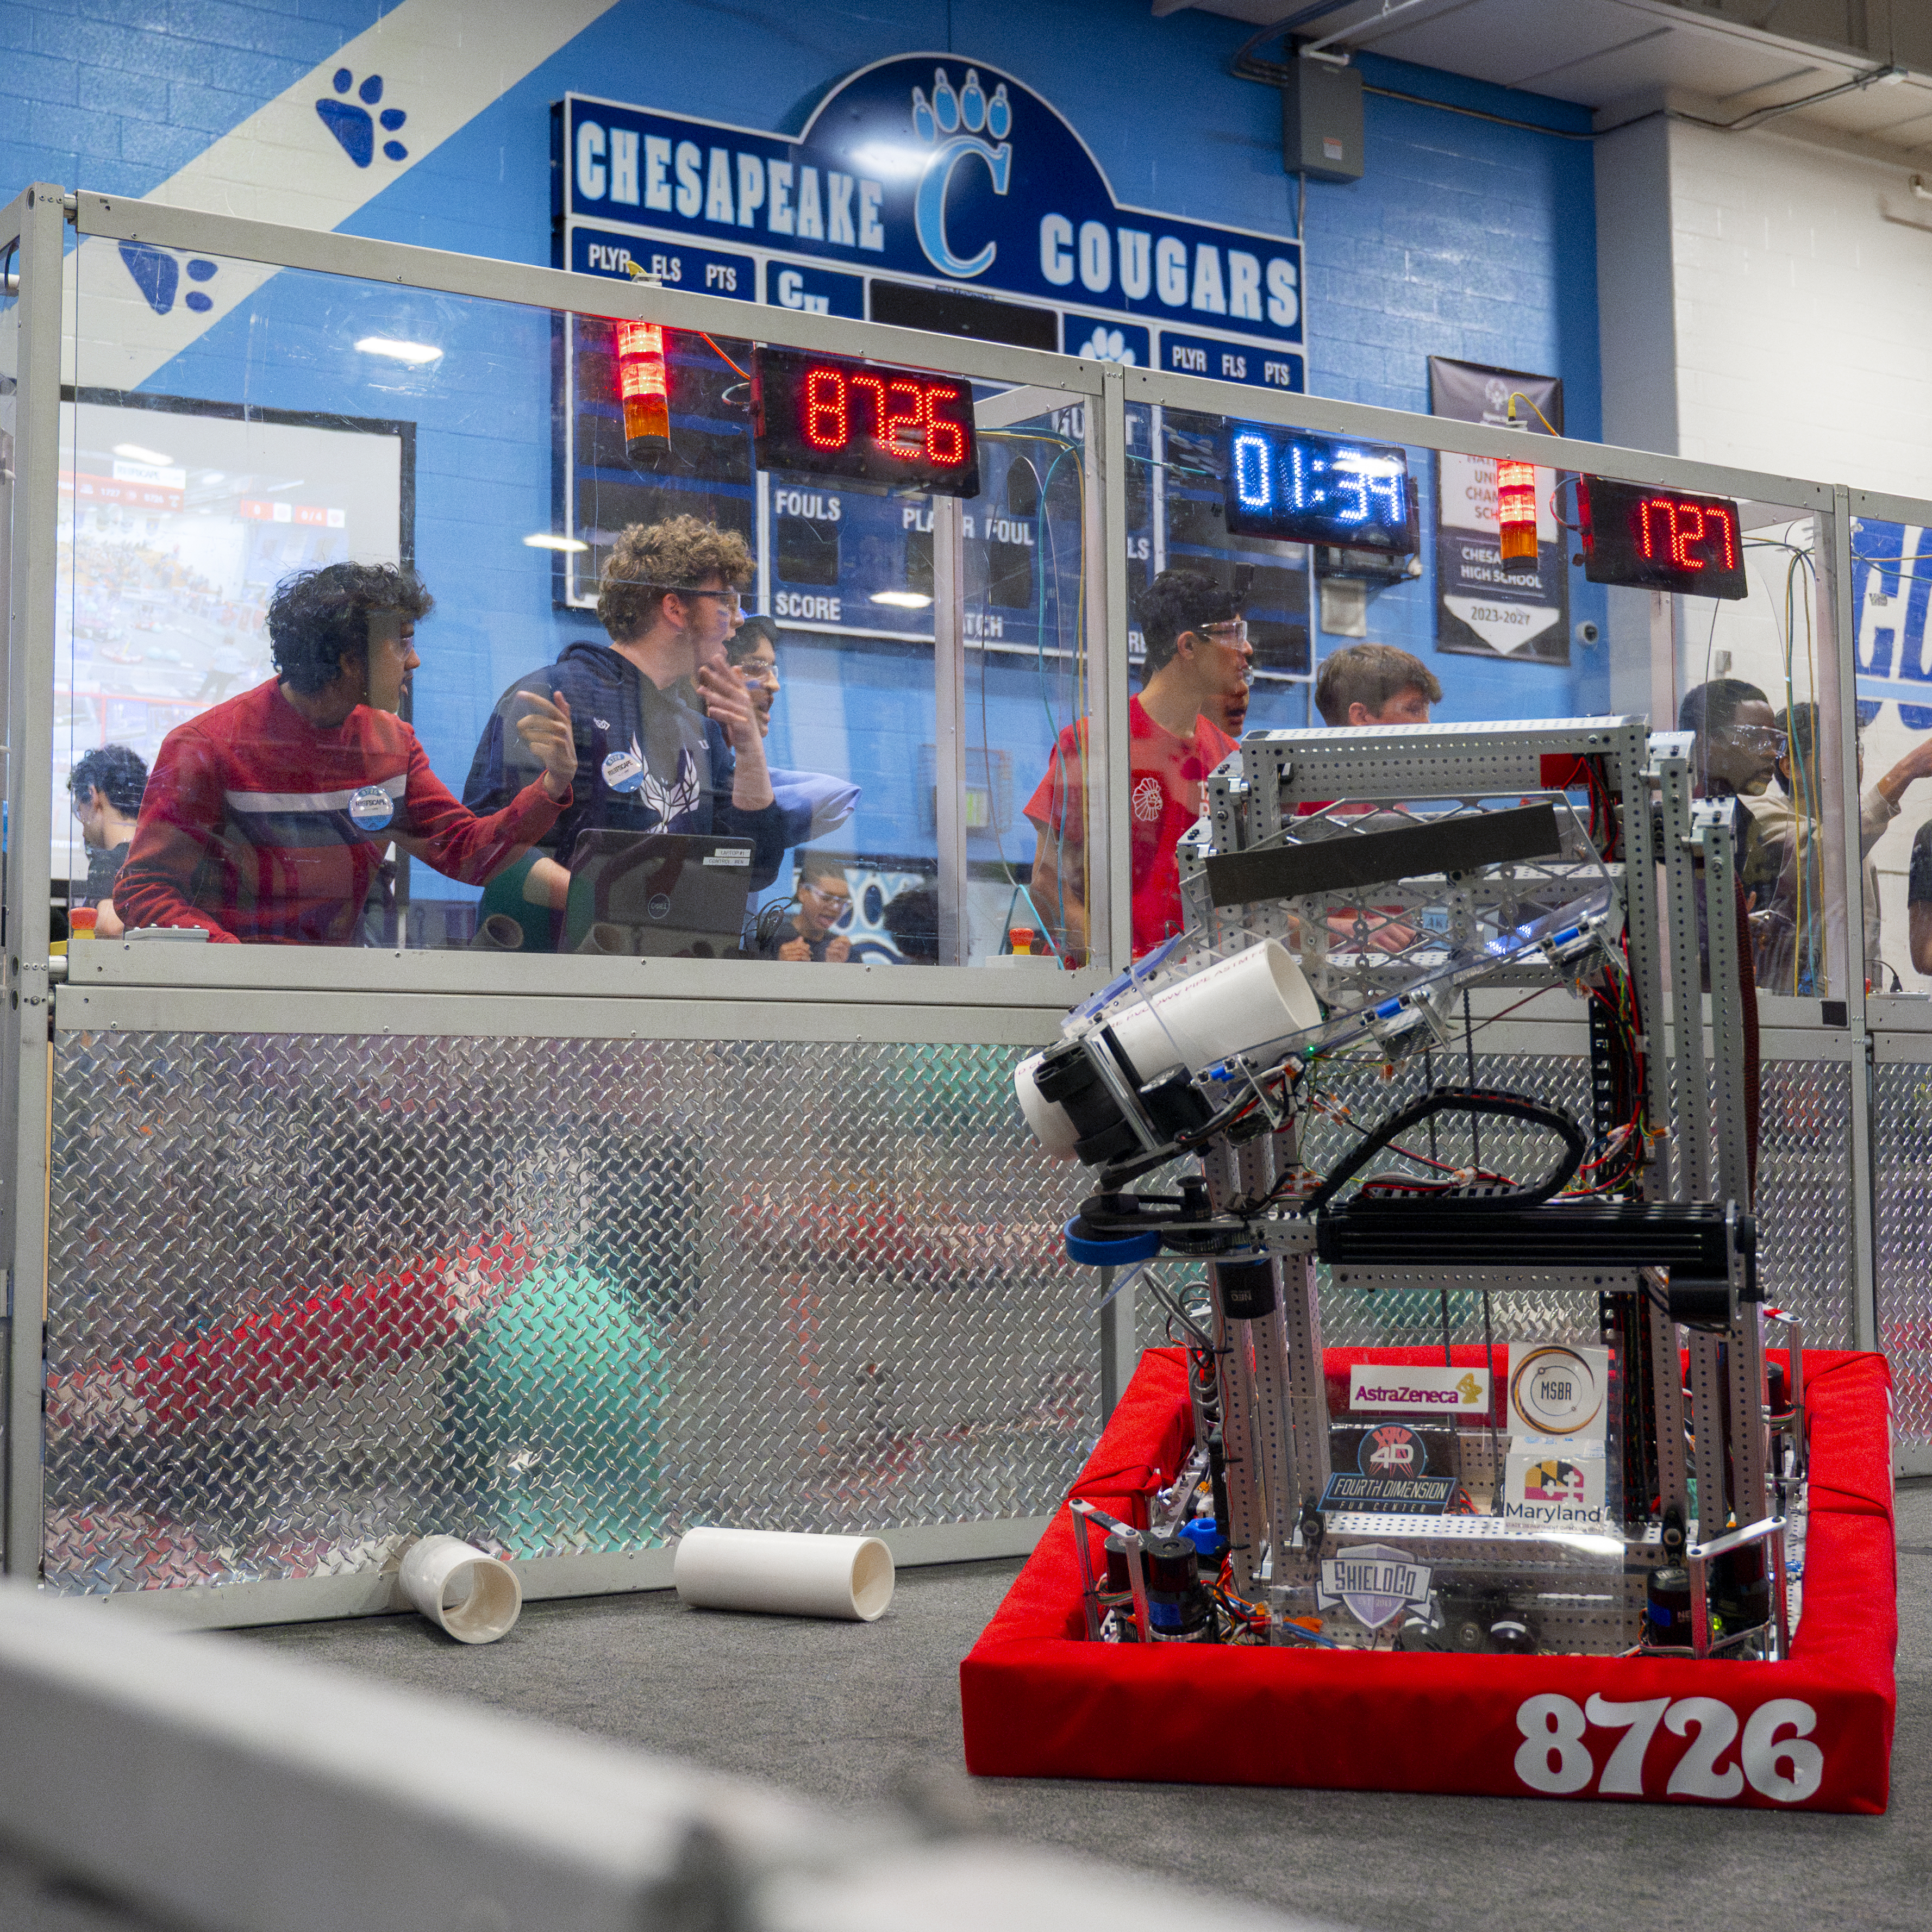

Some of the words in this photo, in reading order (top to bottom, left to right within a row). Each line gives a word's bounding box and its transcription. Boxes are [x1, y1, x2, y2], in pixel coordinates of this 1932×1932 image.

[577, 120, 884, 252] CHESAPEAKE
[589, 244, 632, 273] PLYR
[652, 255, 681, 283] FLS
[706, 265, 737, 292] PTS
[1040, 213, 1299, 327] COUGARS
[1173, 346, 1206, 372] PLYR
[1222, 353, 1246, 379] FLS
[1264, 361, 1290, 385] PTS
[808, 371, 962, 463] 8726
[1234, 434, 1401, 523] 01:39
[776, 490, 841, 521] FOULS
[985, 518, 1034, 546] FOUL
[1641, 498, 1734, 570] 1727
[1461, 546, 1502, 564] CHESA
[1460, 564, 1491, 582] HIGH
[776, 591, 841, 621] SCORE
[1471, 606, 1530, 626] 2023-2027
[1185, 976, 1211, 992] PIPE
[1214, 956, 1248, 977] ASTM
[1355, 1384, 1458, 1404] AstraZeneca
[1540, 1381, 1572, 1401] MSBR
[1370, 1443, 1414, 1468] 4D
[1334, 1478, 1383, 1496] FOURTH
[1382, 1480, 1448, 1499] DIMENSION
[1339, 1500, 1365, 1511] FUN
[1373, 1502, 1427, 1513] CENTER
[1506, 1502, 1601, 1523] Maryland
[1514, 1692, 1824, 1803] 8726
